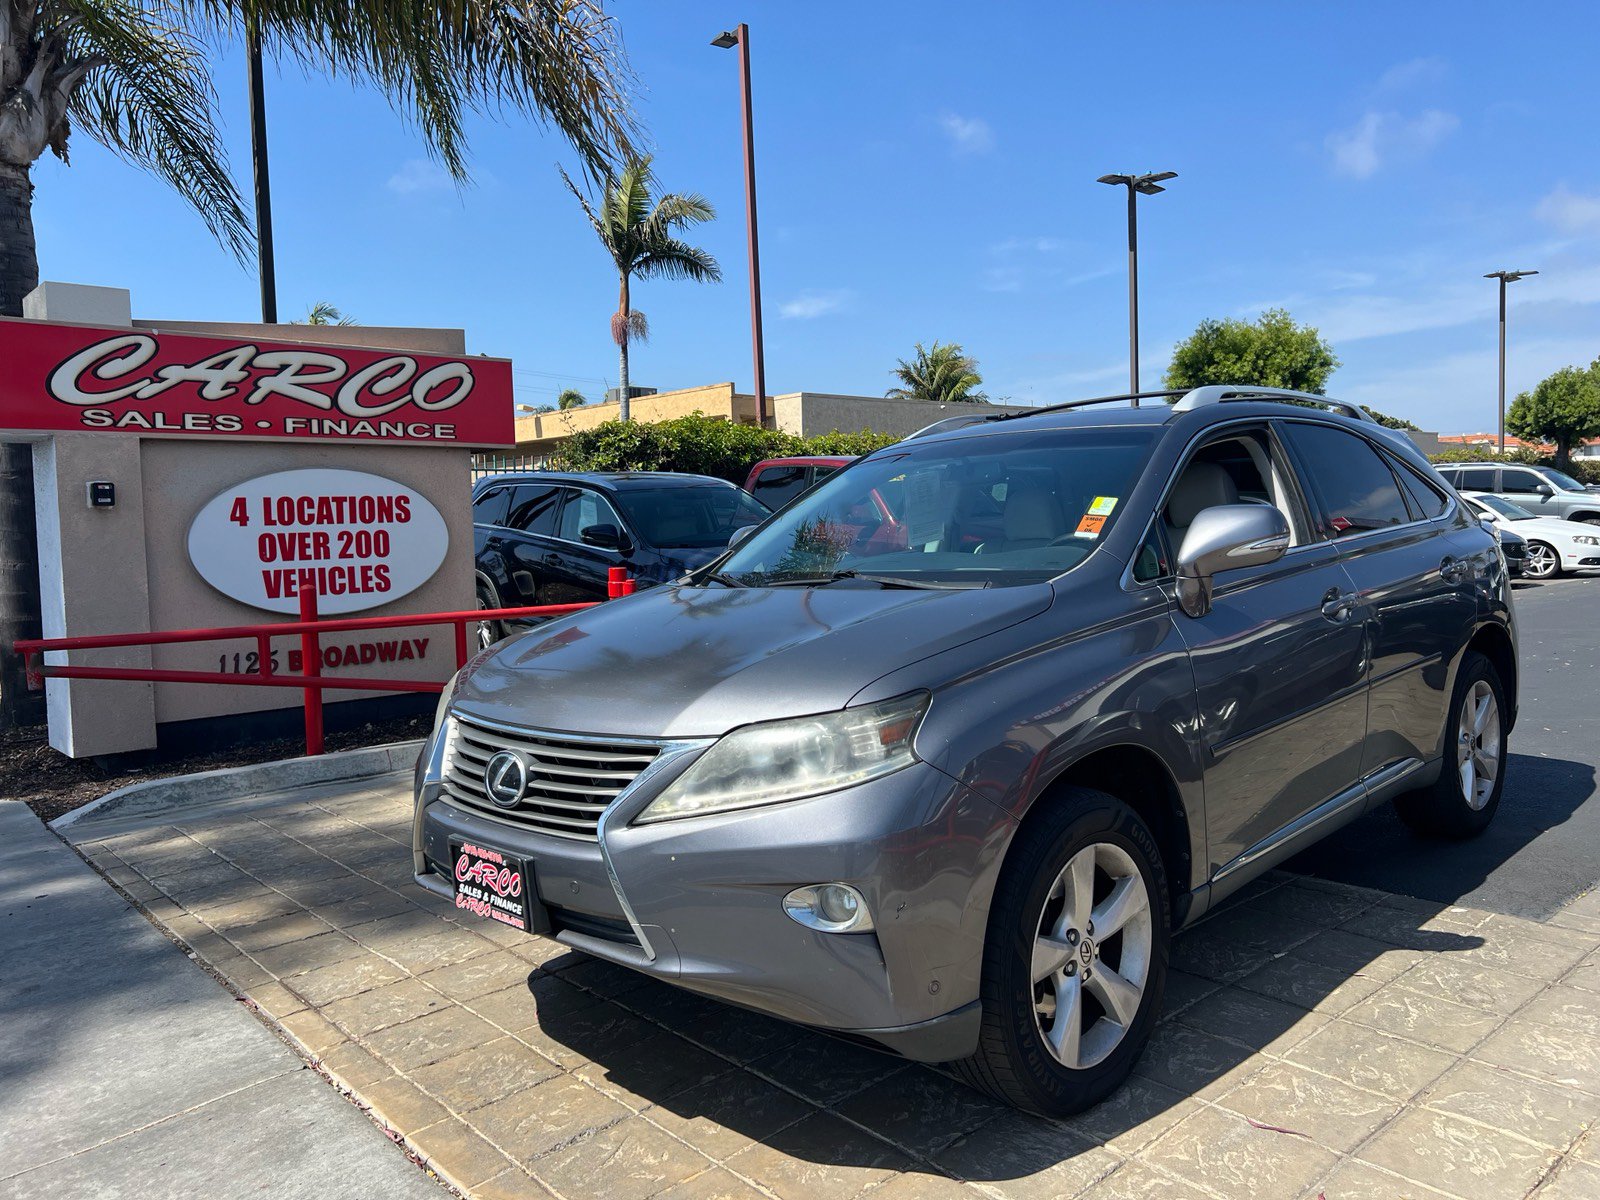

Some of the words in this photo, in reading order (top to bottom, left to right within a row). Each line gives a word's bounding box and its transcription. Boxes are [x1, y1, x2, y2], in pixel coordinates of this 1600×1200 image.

[46, 333, 476, 418] CARCO
[81, 408, 242, 432] SALES
[284, 416, 456, 440] FINANCE
[230, 497, 249, 526] 4
[263, 495, 411, 526] LOCATIONS
[258, 532, 330, 562] OVER
[337, 529, 390, 559] 200
[262, 564, 391, 598] VEHICLES
[288, 638, 429, 671] BOADWAY
[455, 854, 521, 897] CARCO
[459, 883, 482, 899] SALES
[483, 892, 489, 902] &
[490, 894, 523, 915] FINANCE
